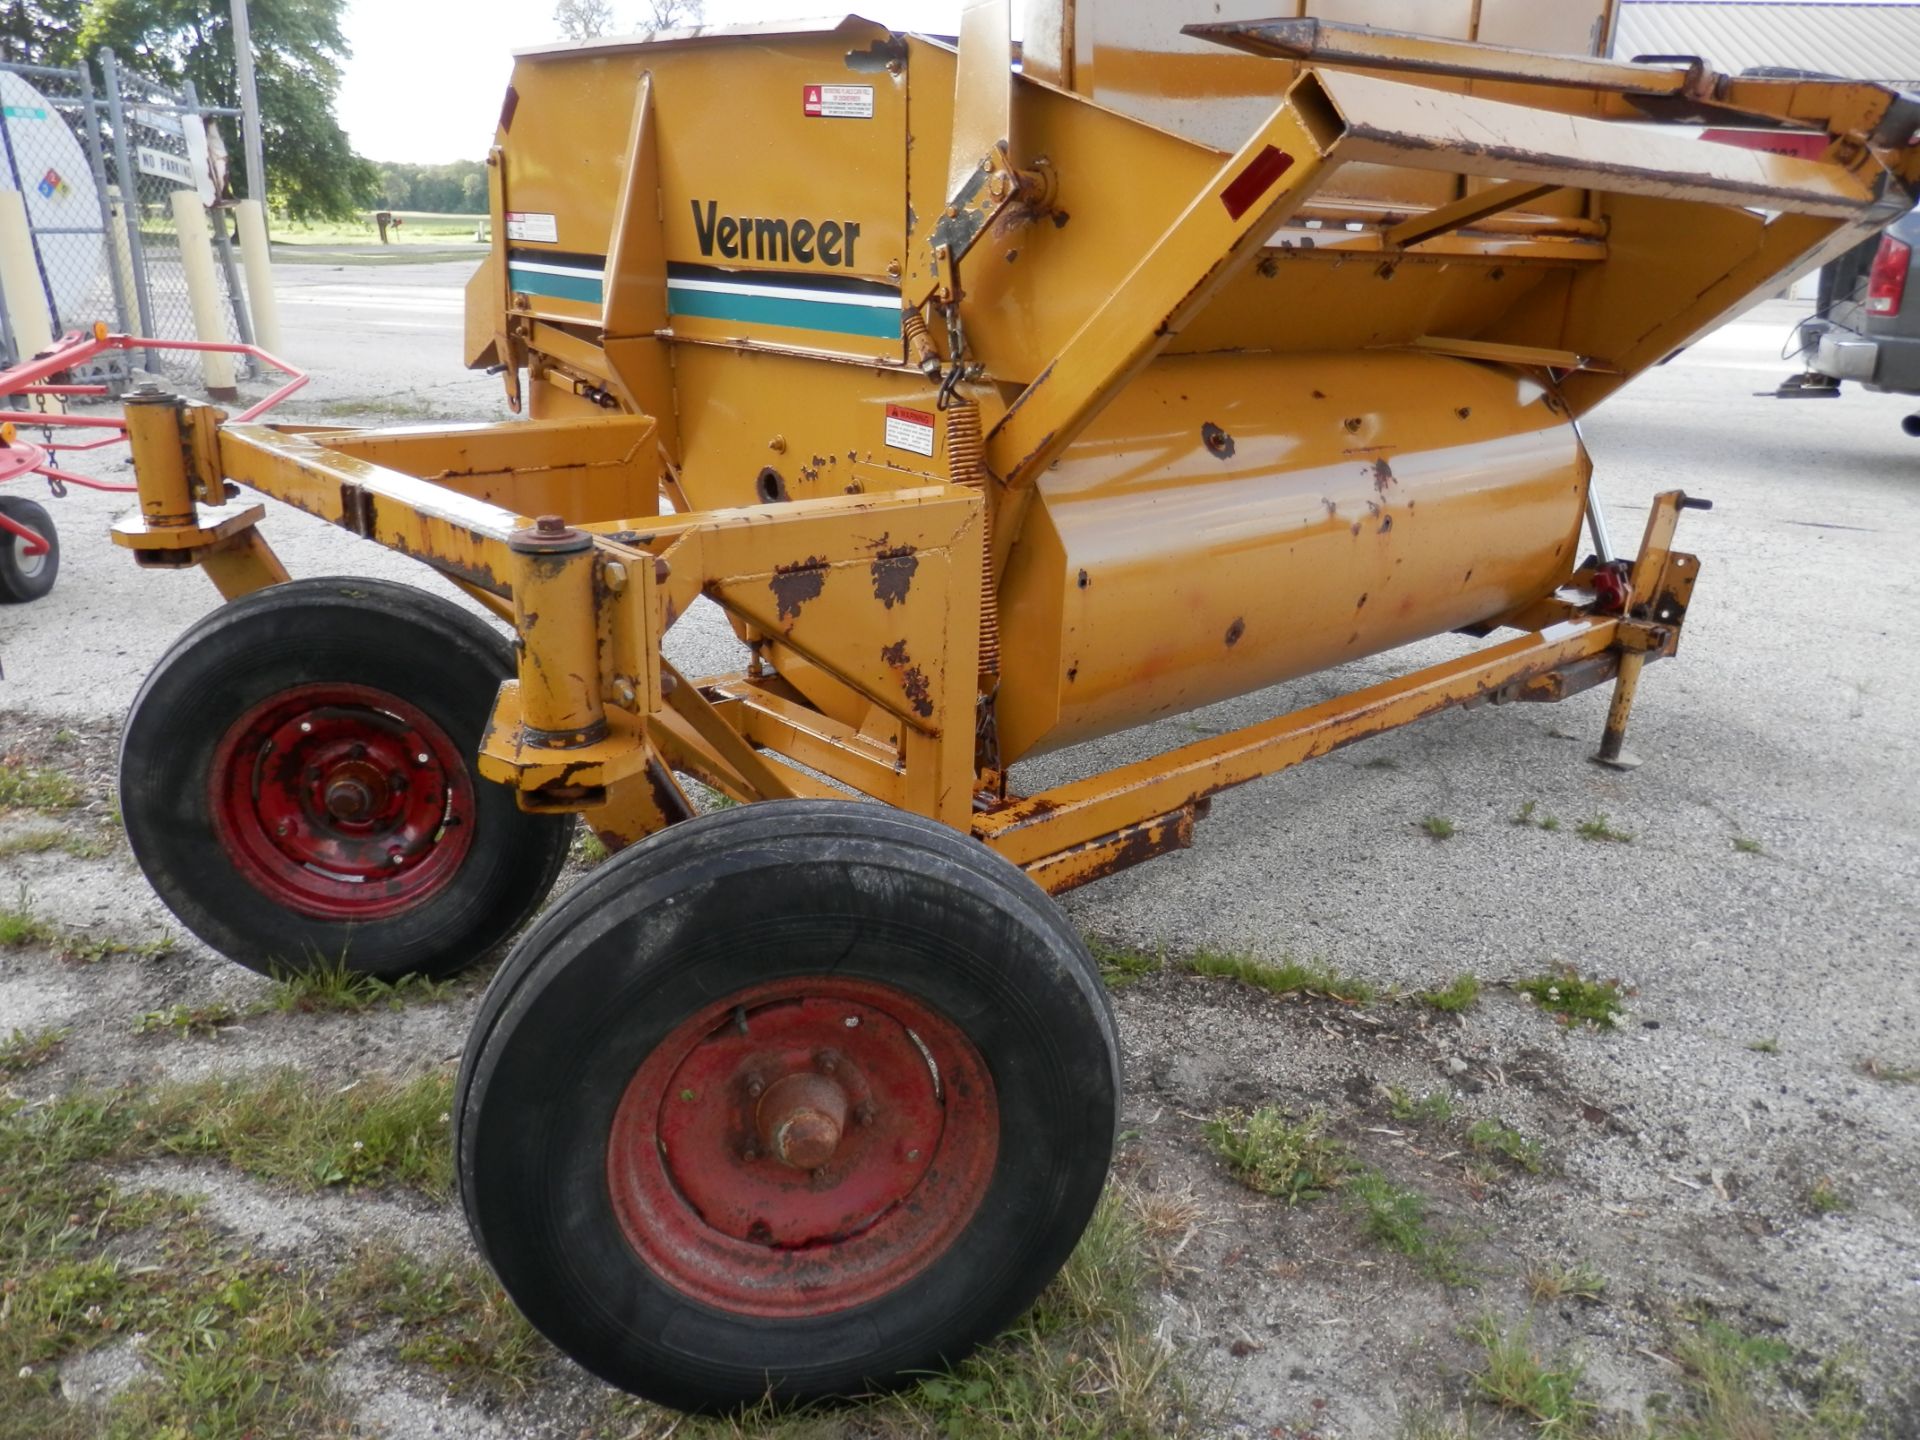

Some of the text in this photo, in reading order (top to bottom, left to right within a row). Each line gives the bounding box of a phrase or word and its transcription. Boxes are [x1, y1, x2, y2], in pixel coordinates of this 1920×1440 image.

[142, 153, 192, 179] NO PARKING
[690, 199, 861, 267] Vermeer
